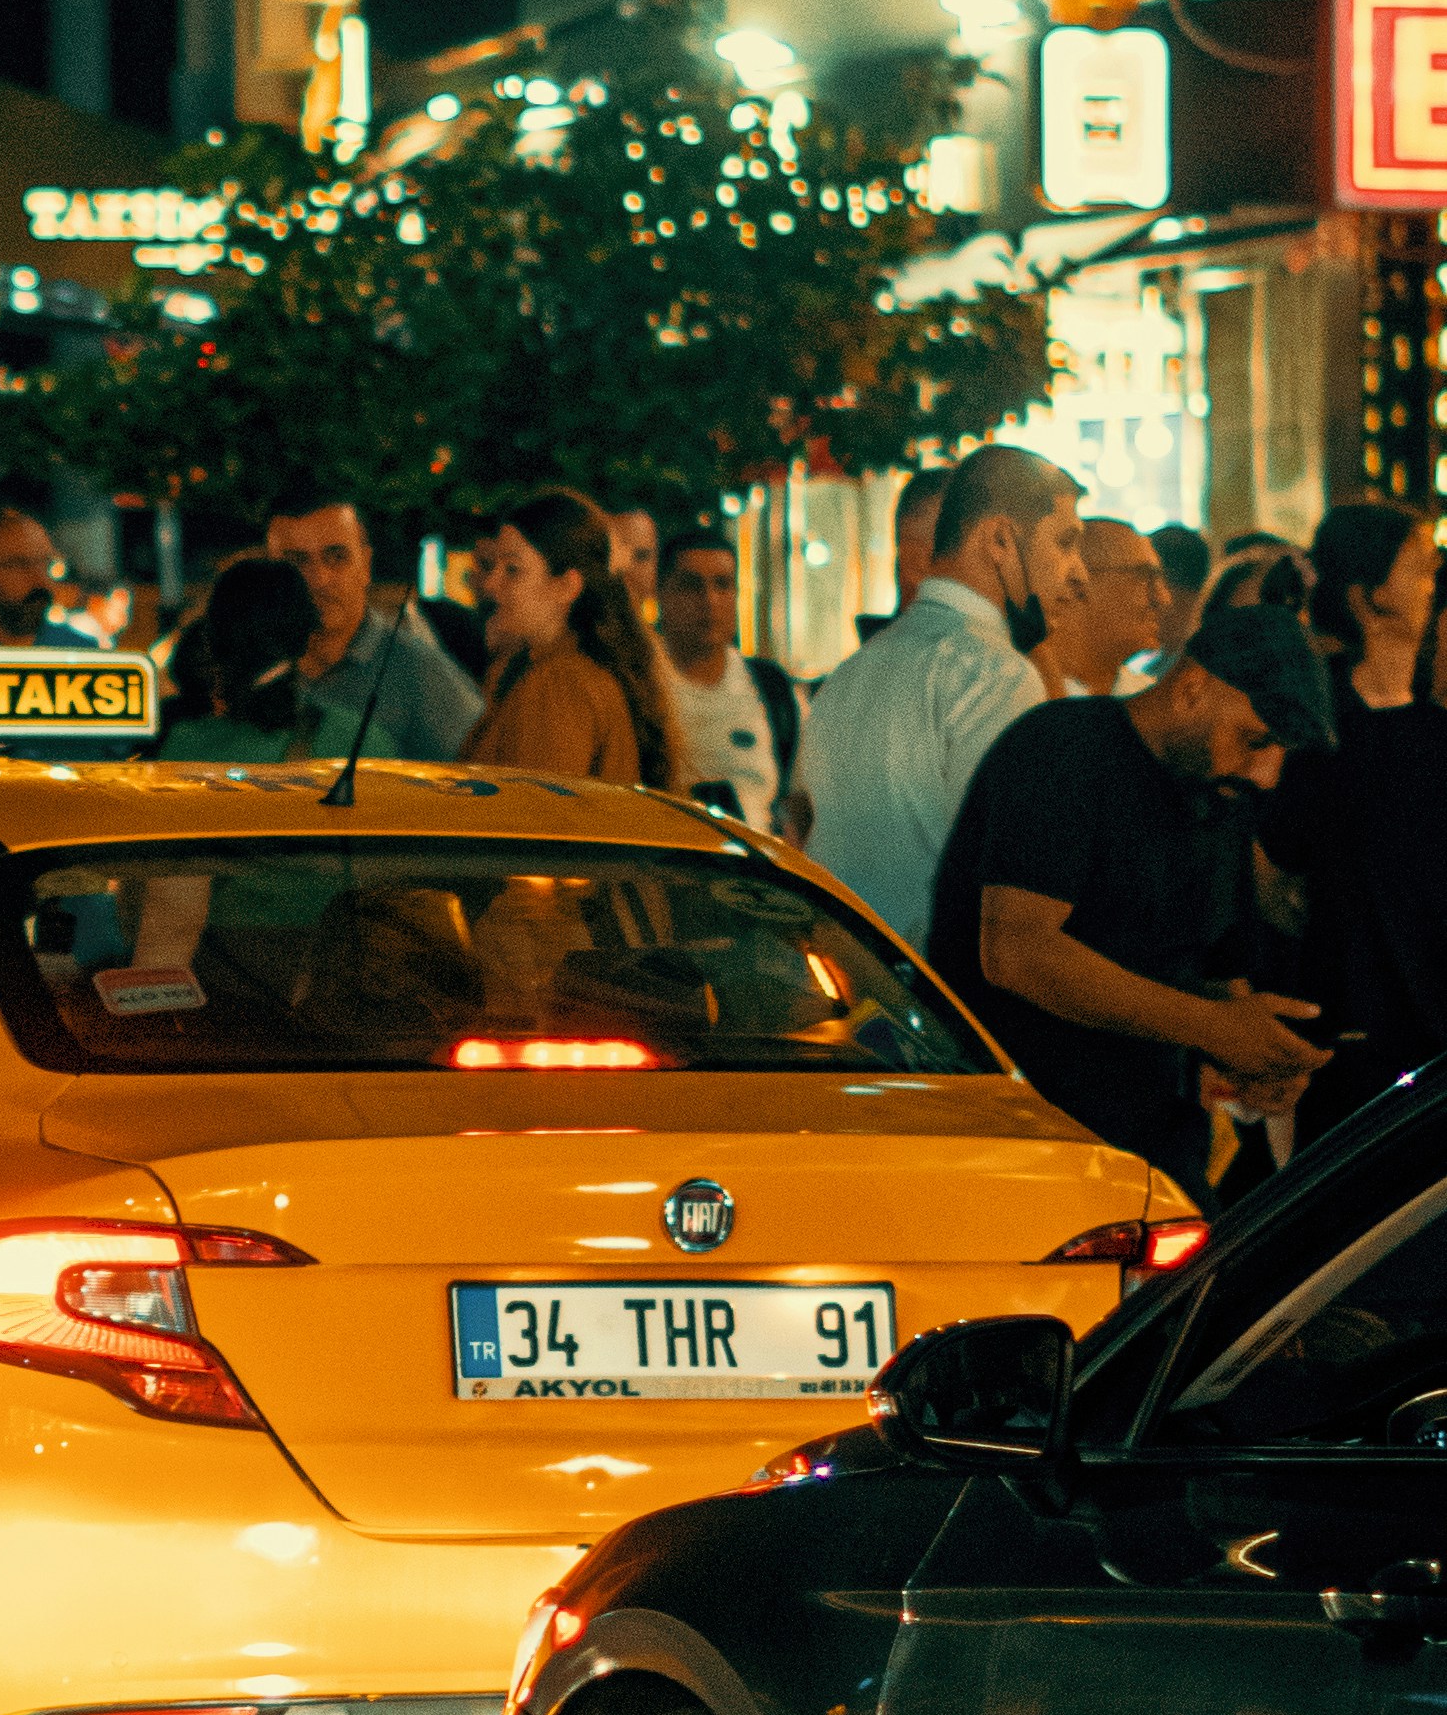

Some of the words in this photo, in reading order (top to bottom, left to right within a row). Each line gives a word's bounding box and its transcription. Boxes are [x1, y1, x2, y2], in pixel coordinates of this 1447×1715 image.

[682, 1201, 722, 1233] FIAT
[469, 1340, 496, 1361] TR
[504, 1299, 580, 1368] 34
[623, 1298, 739, 1369] THR
[814, 1301, 879, 1369] 91
[513, 1378, 642, 1398] AKYOL
